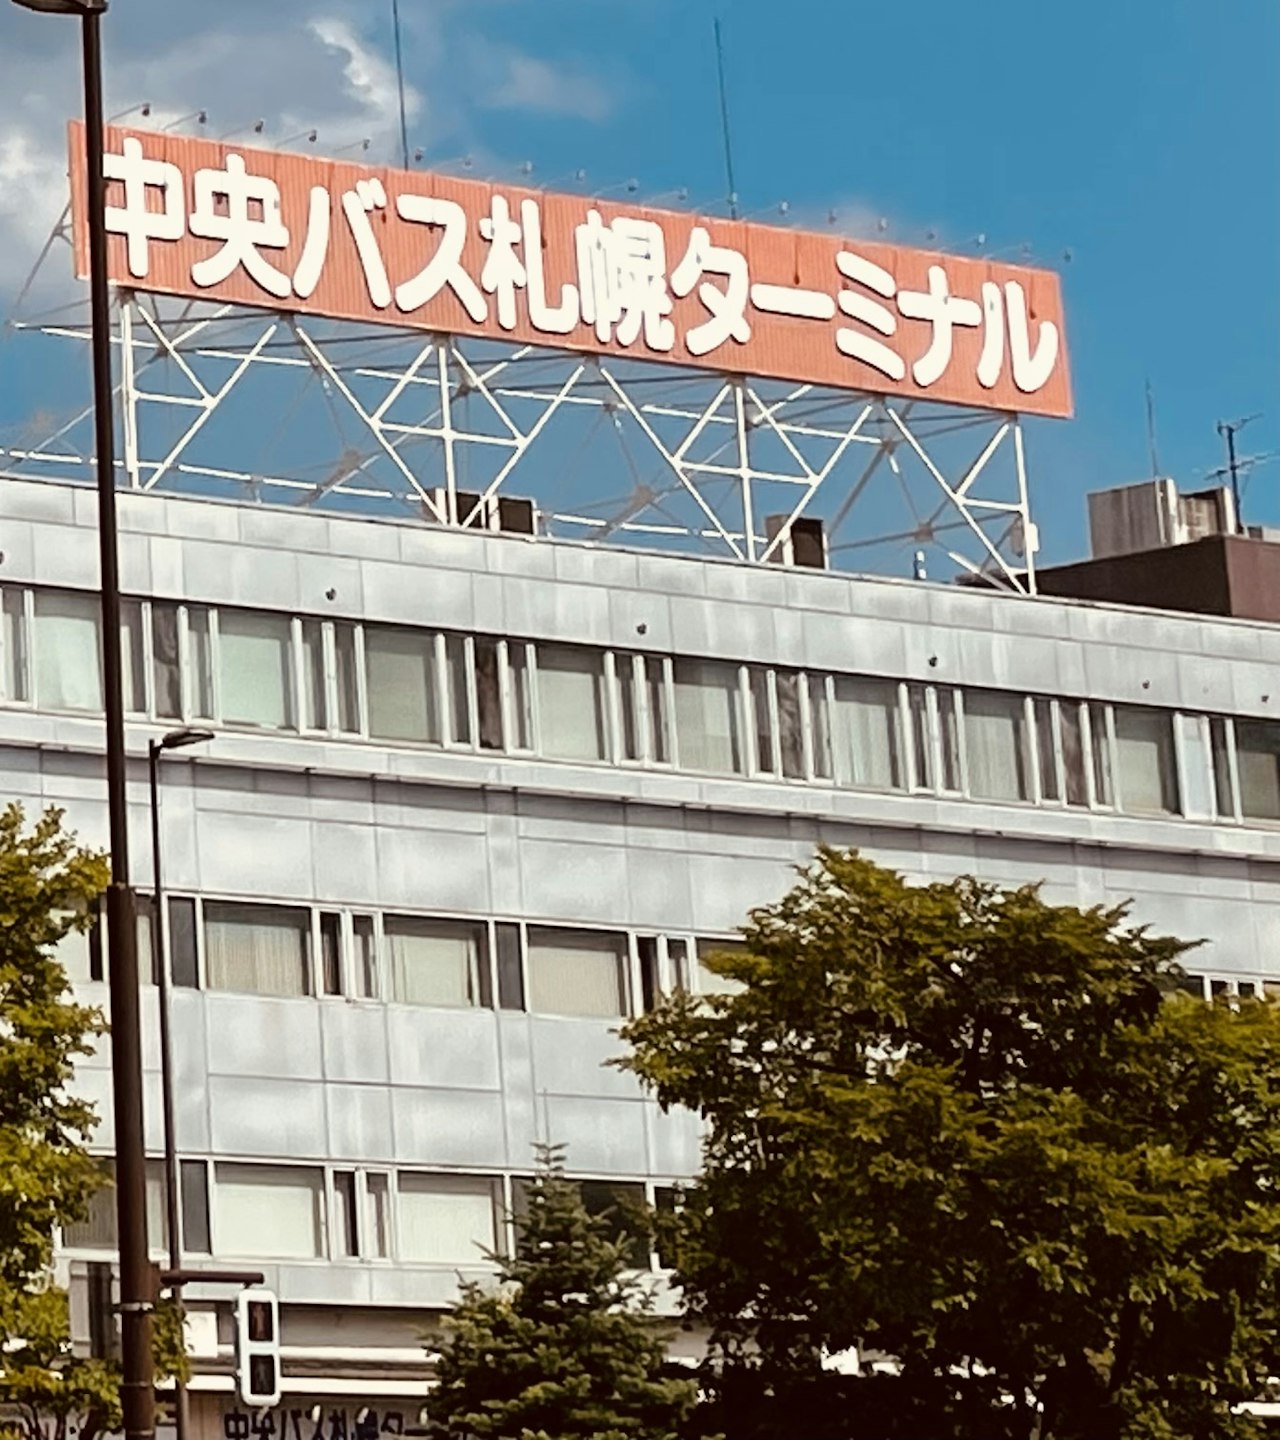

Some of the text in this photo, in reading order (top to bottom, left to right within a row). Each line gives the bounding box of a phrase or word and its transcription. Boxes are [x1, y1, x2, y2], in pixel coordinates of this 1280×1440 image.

[103, 137, 1058, 393] 中央バス札幌ターミナル
